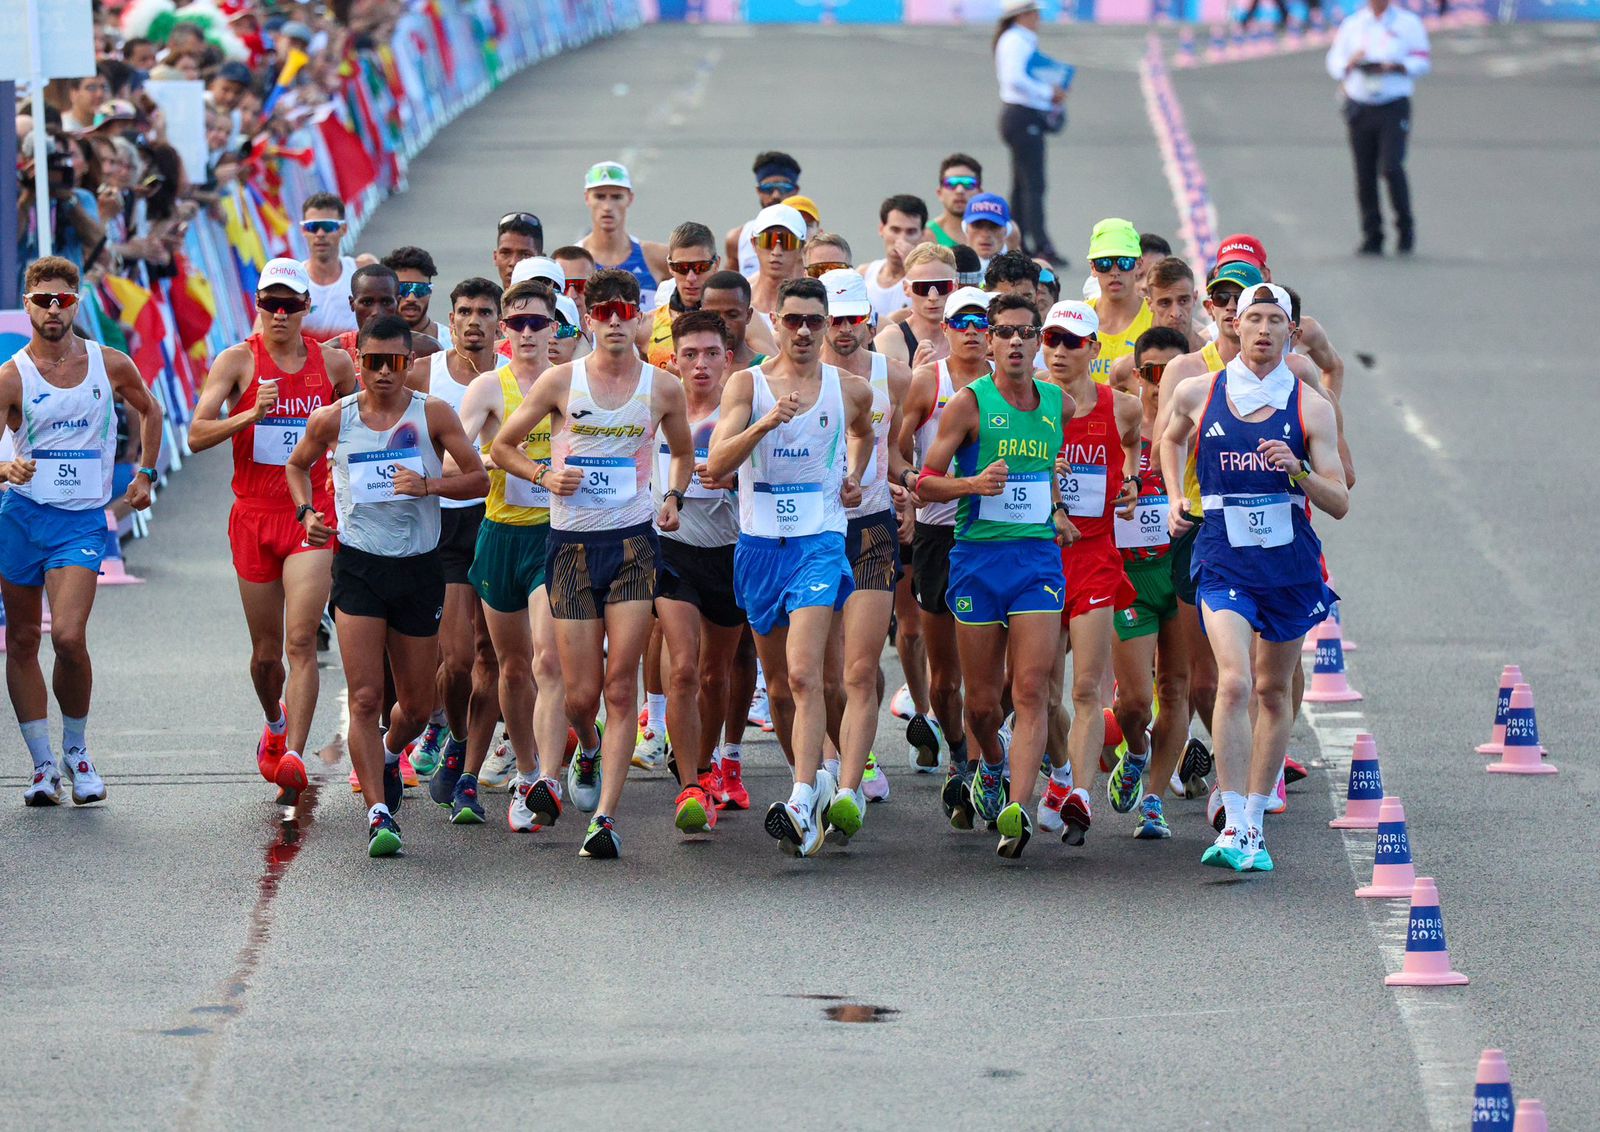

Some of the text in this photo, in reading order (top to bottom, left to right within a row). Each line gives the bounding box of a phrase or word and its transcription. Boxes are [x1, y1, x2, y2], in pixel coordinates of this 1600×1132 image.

[1222, 243, 1256, 254] CANADA
[269, 267, 297, 277] CHINA
[1052, 310, 1083, 321] CHINA
[52, 418, 89, 430] ITALIA
[282, 431, 299, 446] 21
[772, 447, 810, 458] ITALIA
[997, 438, 1049, 461] BRASIL
[366, 451, 404, 460] PARIS 2024
[1219, 452, 1285, 472] FRANC
[58, 463, 77, 478] 54
[375, 464, 397, 480] 43
[53, 479, 82, 487] ORSONI
[588, 471, 610, 486] 34
[1059, 478, 1079, 493] 23
[1011, 487, 1027, 502] 15
[776, 498, 797, 514] 55
[1004, 502, 1032, 511] BONFIM
[1139, 509, 1161, 525] 65
[1248, 510, 1265, 527] 37
[1140, 525, 1162, 534] ORTIZ
[1506, 718, 1534, 728] PARIS
[1506, 727, 1535, 737] 2024
[1352, 770, 1380, 780] PARIS
[1352, 780, 1381, 790] 2024
[1377, 833, 1407, 843] PARIS
[1377, 844, 1408, 854] 2024
[1410, 918, 1443, 929] PARIS
[1411, 929, 1444, 940] 2024
